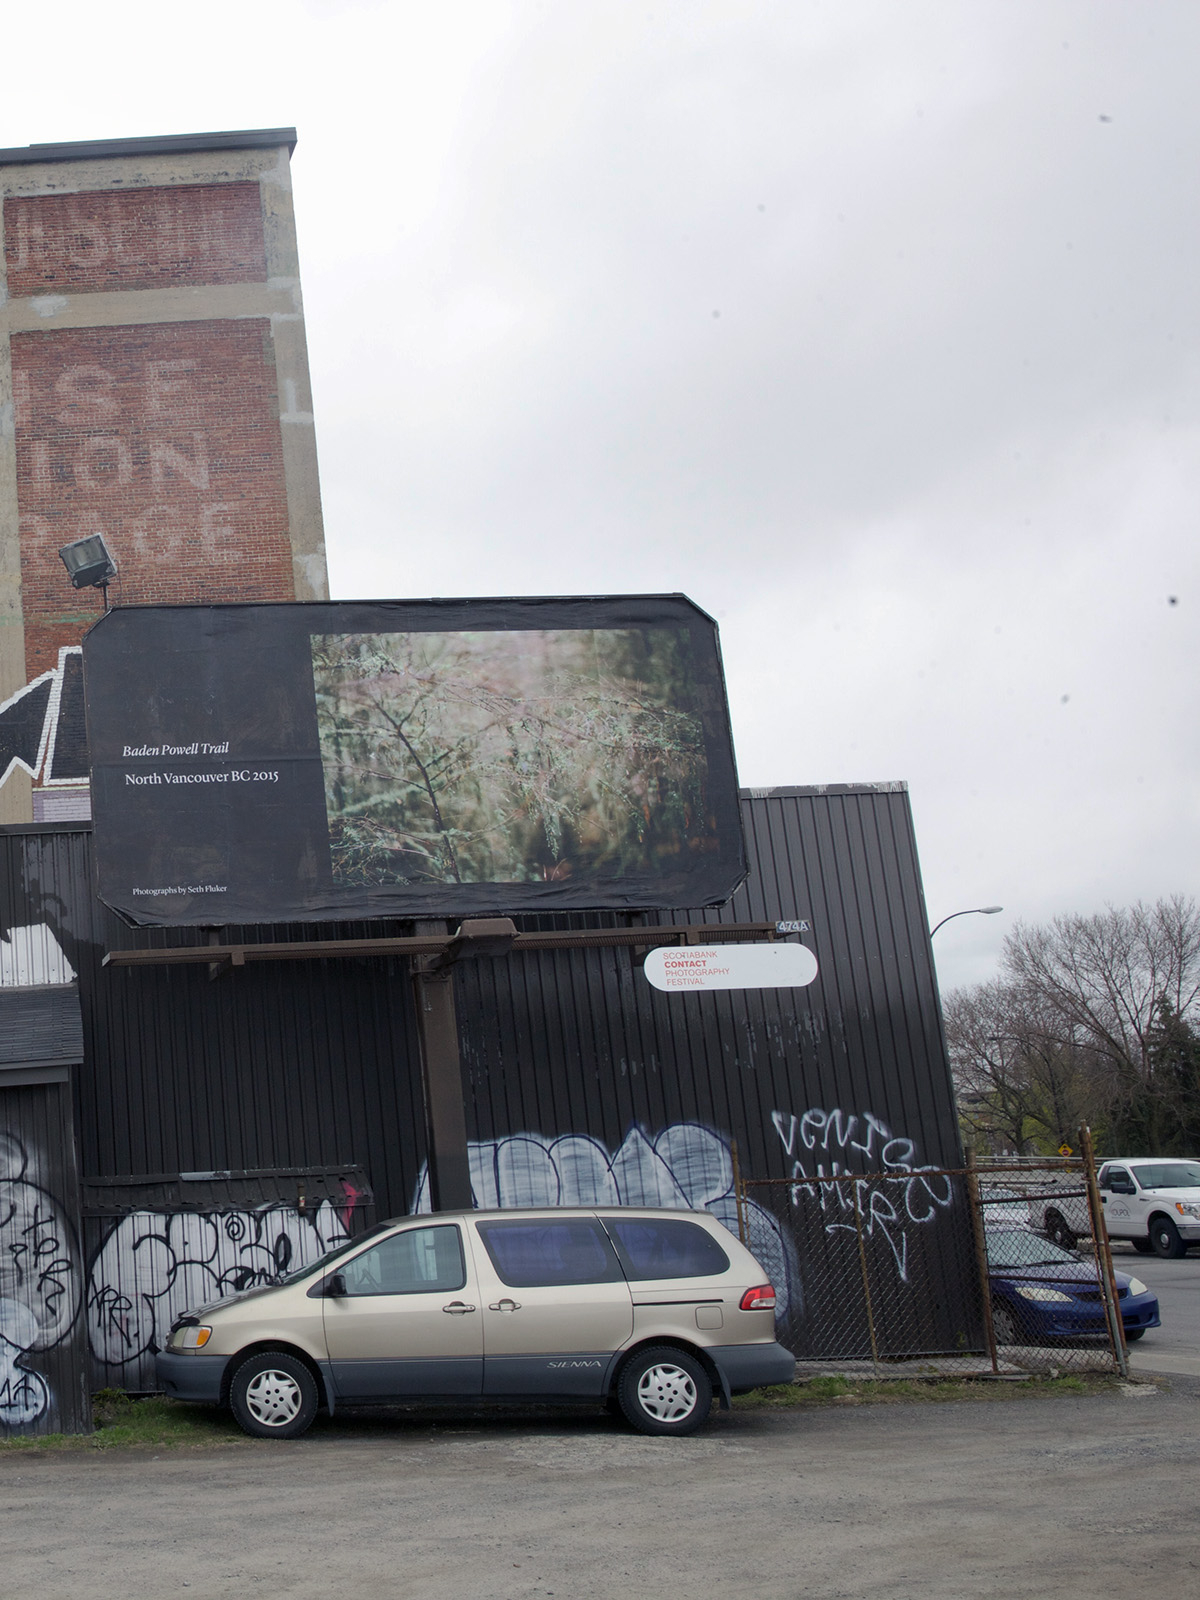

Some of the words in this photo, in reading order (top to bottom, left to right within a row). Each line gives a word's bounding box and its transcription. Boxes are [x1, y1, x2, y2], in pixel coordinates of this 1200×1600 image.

[123, 745, 159, 757] Baden
[161, 743, 198, 755] Powell
[201, 742, 229, 754] Trail
[125, 773, 161, 785] North
[163, 773, 229, 784] Vancouver
[231, 770, 251, 782] BC
[252, 771, 279, 783] 2015
[132, 887, 177, 896] Photographs
[178, 886, 187, 896] by
[187, 885, 205, 894] Seth
[205, 884, 228, 893] Fluker
[778, 921, 809, 932] 474A
[663, 951, 718, 960] SCOTIABANK
[664, 959, 707, 968] CONTACT
[665, 967, 730, 977] PHOTOGRAPHY
[667, 978, 705, 986] FESTIVAL
[546, 1360, 602, 1368] SIENNA
